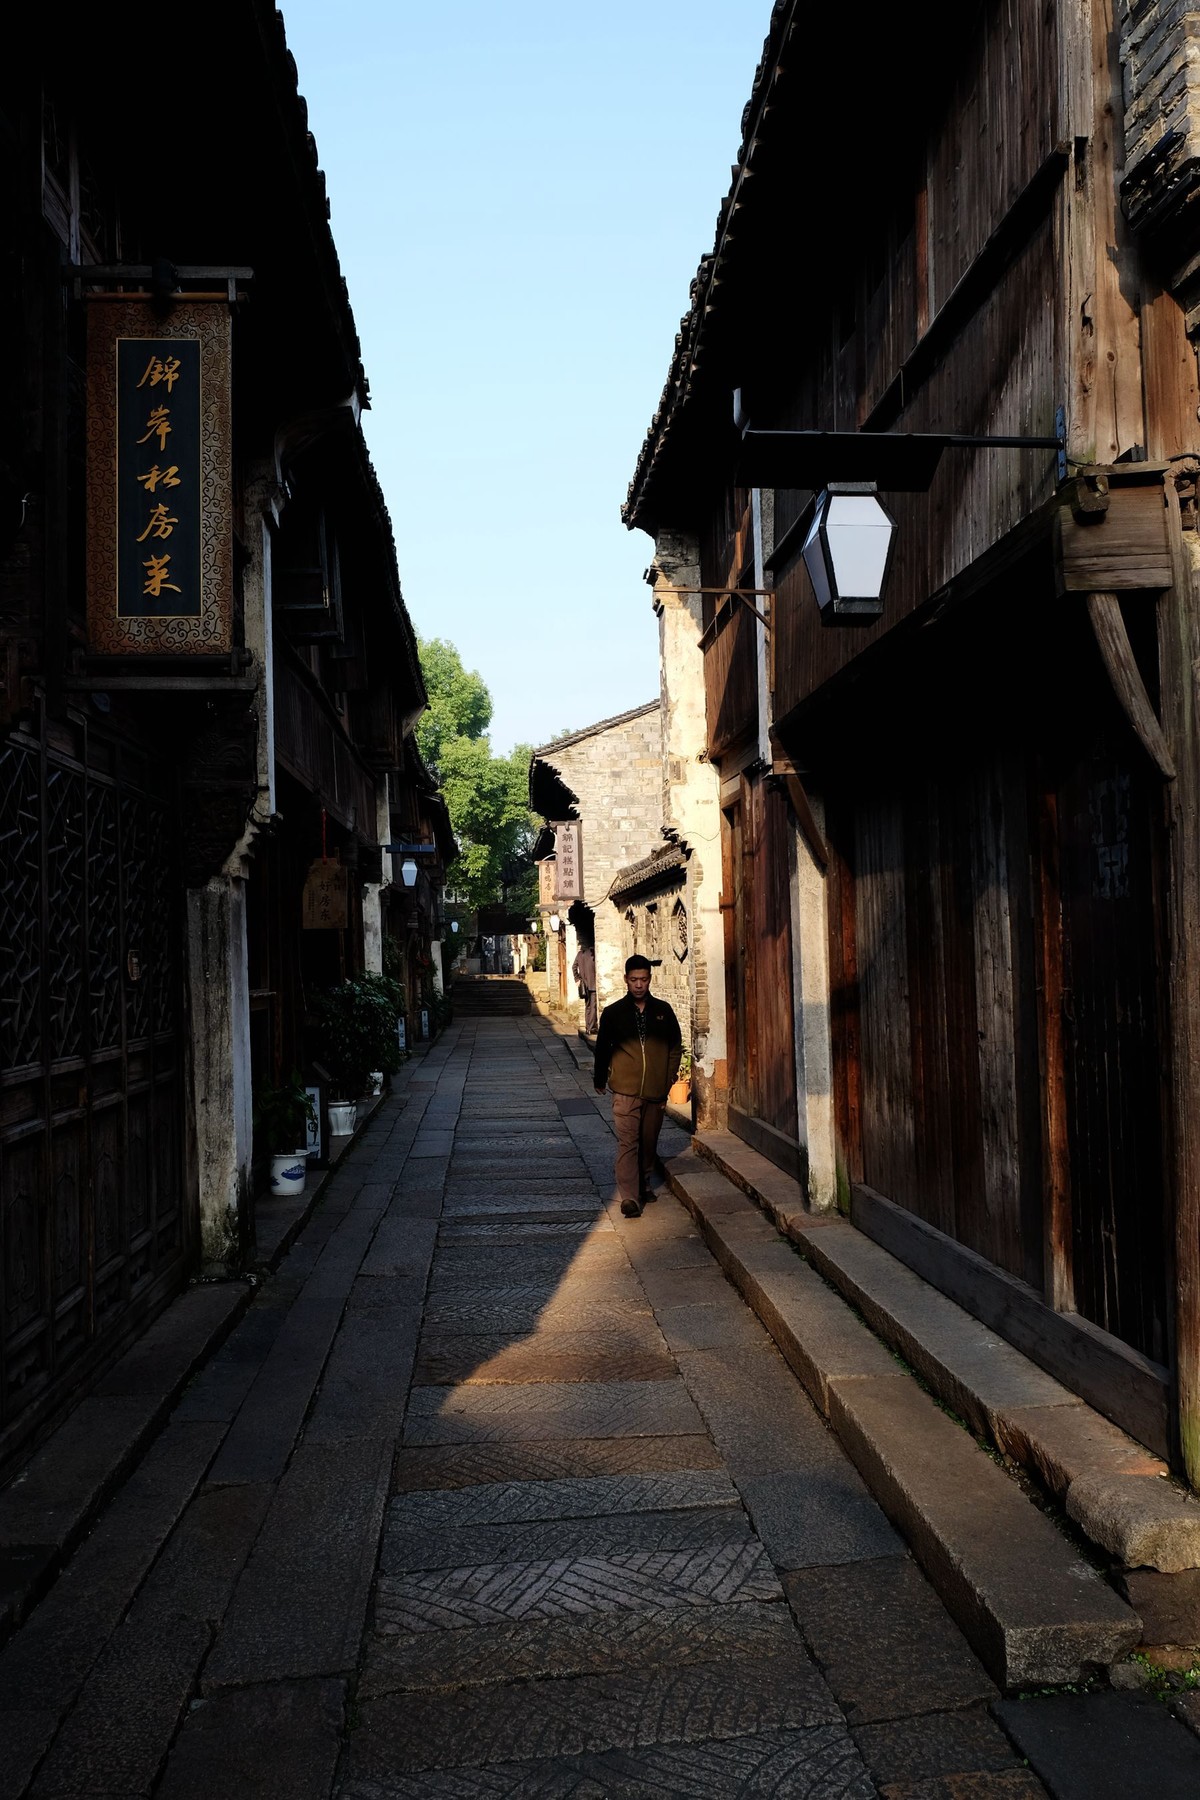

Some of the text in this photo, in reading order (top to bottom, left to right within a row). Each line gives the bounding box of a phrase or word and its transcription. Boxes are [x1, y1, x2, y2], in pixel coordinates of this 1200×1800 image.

[136, 355, 182, 597] 錦岸私房菜
